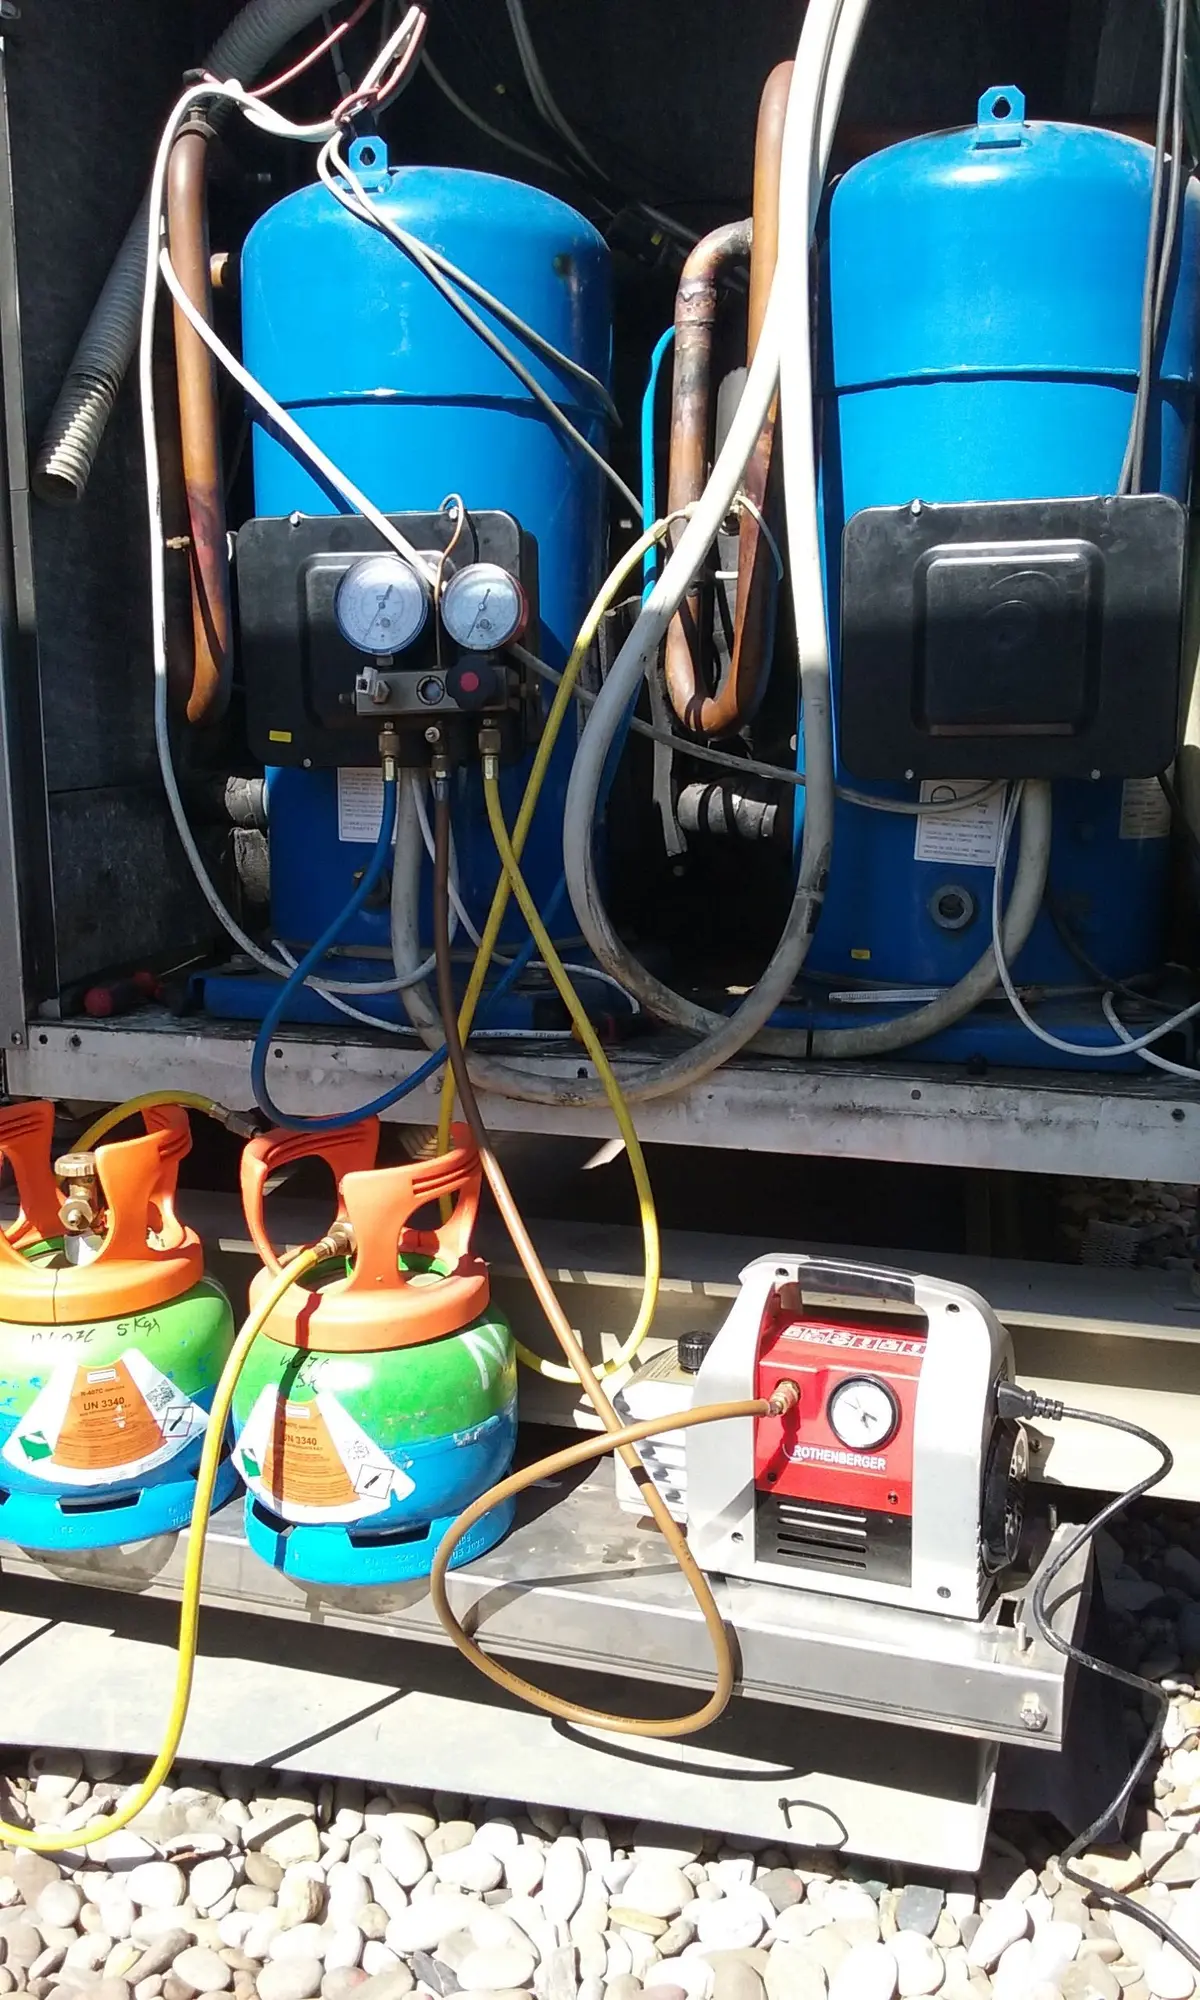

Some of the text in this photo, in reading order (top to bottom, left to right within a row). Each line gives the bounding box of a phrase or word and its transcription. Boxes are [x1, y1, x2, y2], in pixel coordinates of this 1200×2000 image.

[83, 1396, 125, 1411] UN 3340
[295, 1435, 318, 1446] 3340
[792, 1444, 887, 1470] ROTHENBERGER
